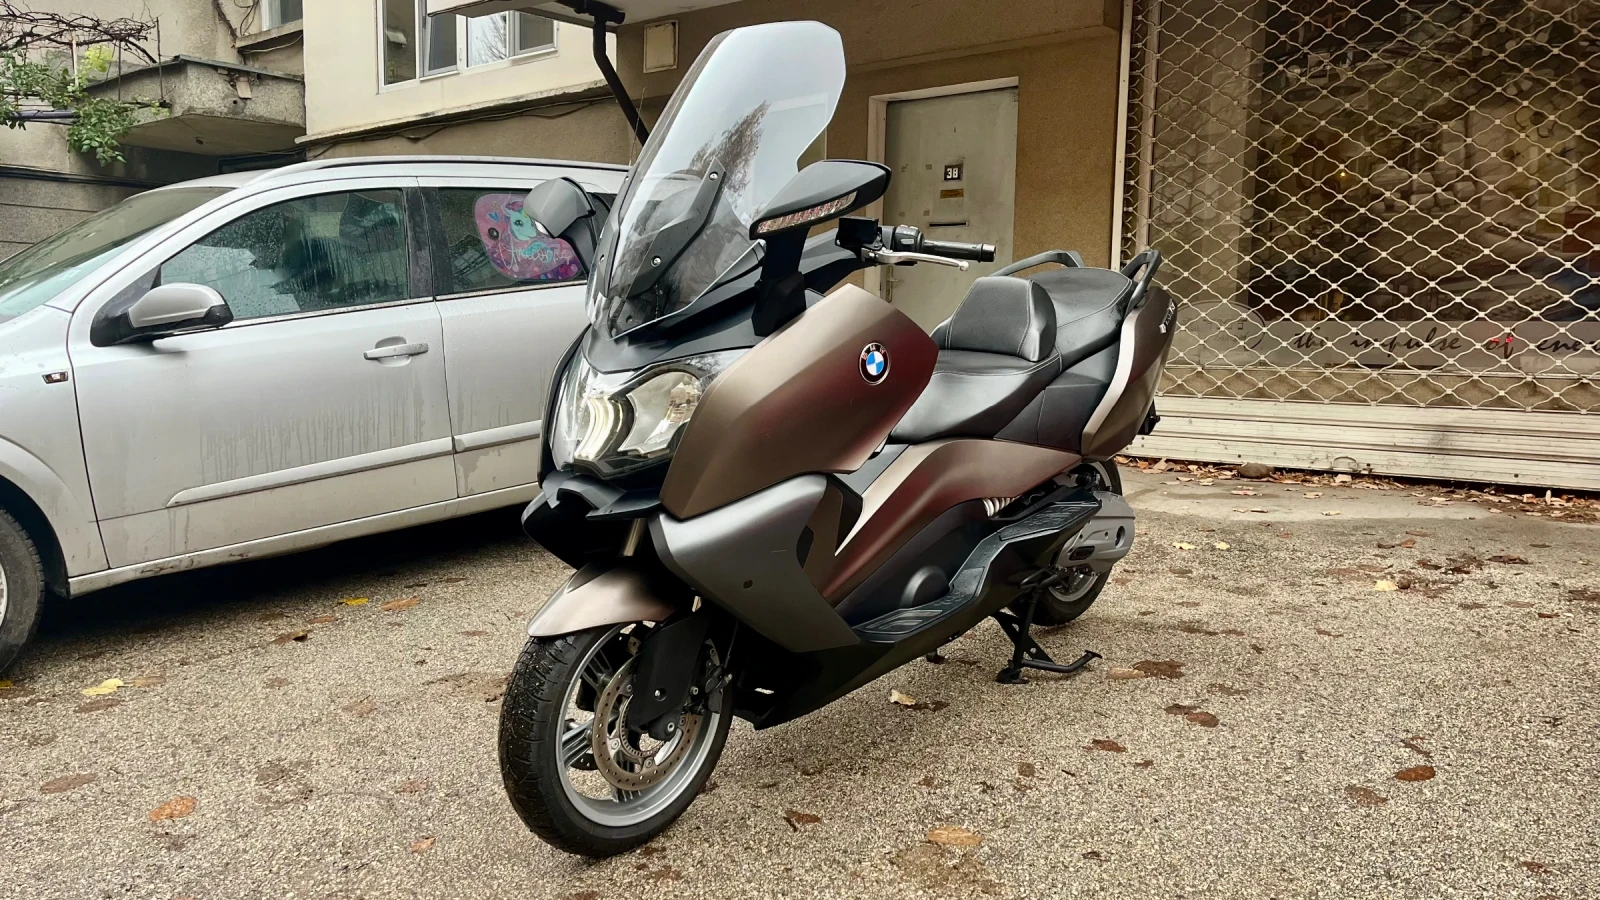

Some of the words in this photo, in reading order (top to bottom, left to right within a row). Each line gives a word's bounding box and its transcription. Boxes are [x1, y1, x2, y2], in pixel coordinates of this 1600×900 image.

[946, 167, 959, 179] 38
[1294, 326, 1330, 349] the
[1350, 326, 1462, 358] impulse
[1485, 328, 1516, 359] of
